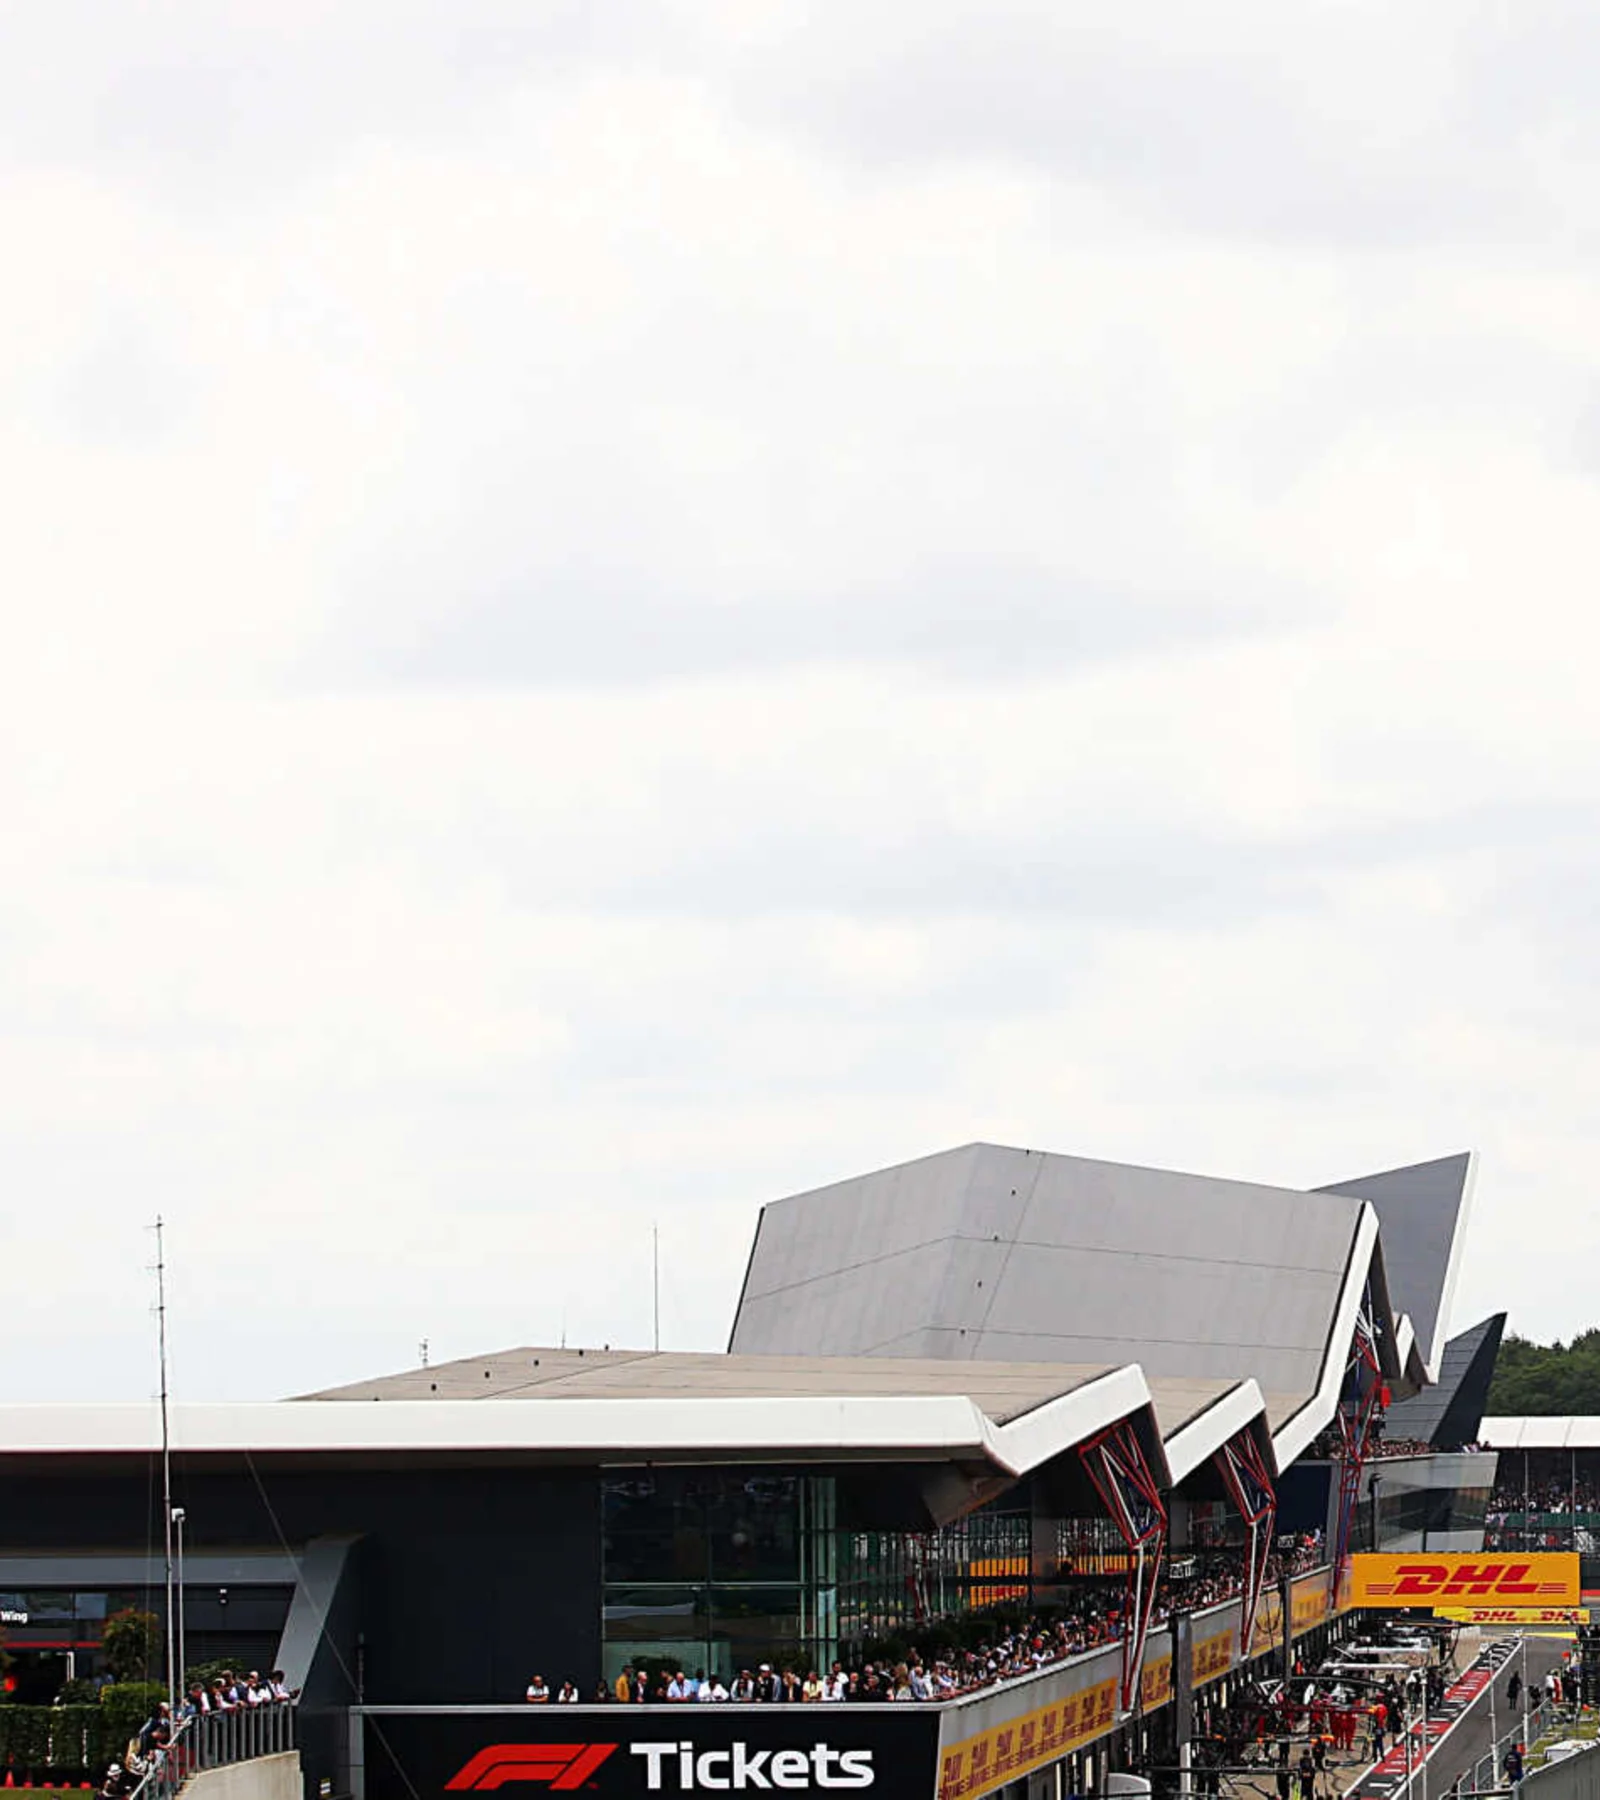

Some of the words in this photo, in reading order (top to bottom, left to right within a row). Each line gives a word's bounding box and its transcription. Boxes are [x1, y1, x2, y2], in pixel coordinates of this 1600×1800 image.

[1393, 1565, 1539, 1594] DHL
[0, 1611, 28, 1624] Wing
[1473, 1611, 1516, 1621] DHL
[444, 1743, 619, 1789] F1
[630, 1741, 875, 1789] Tickets
